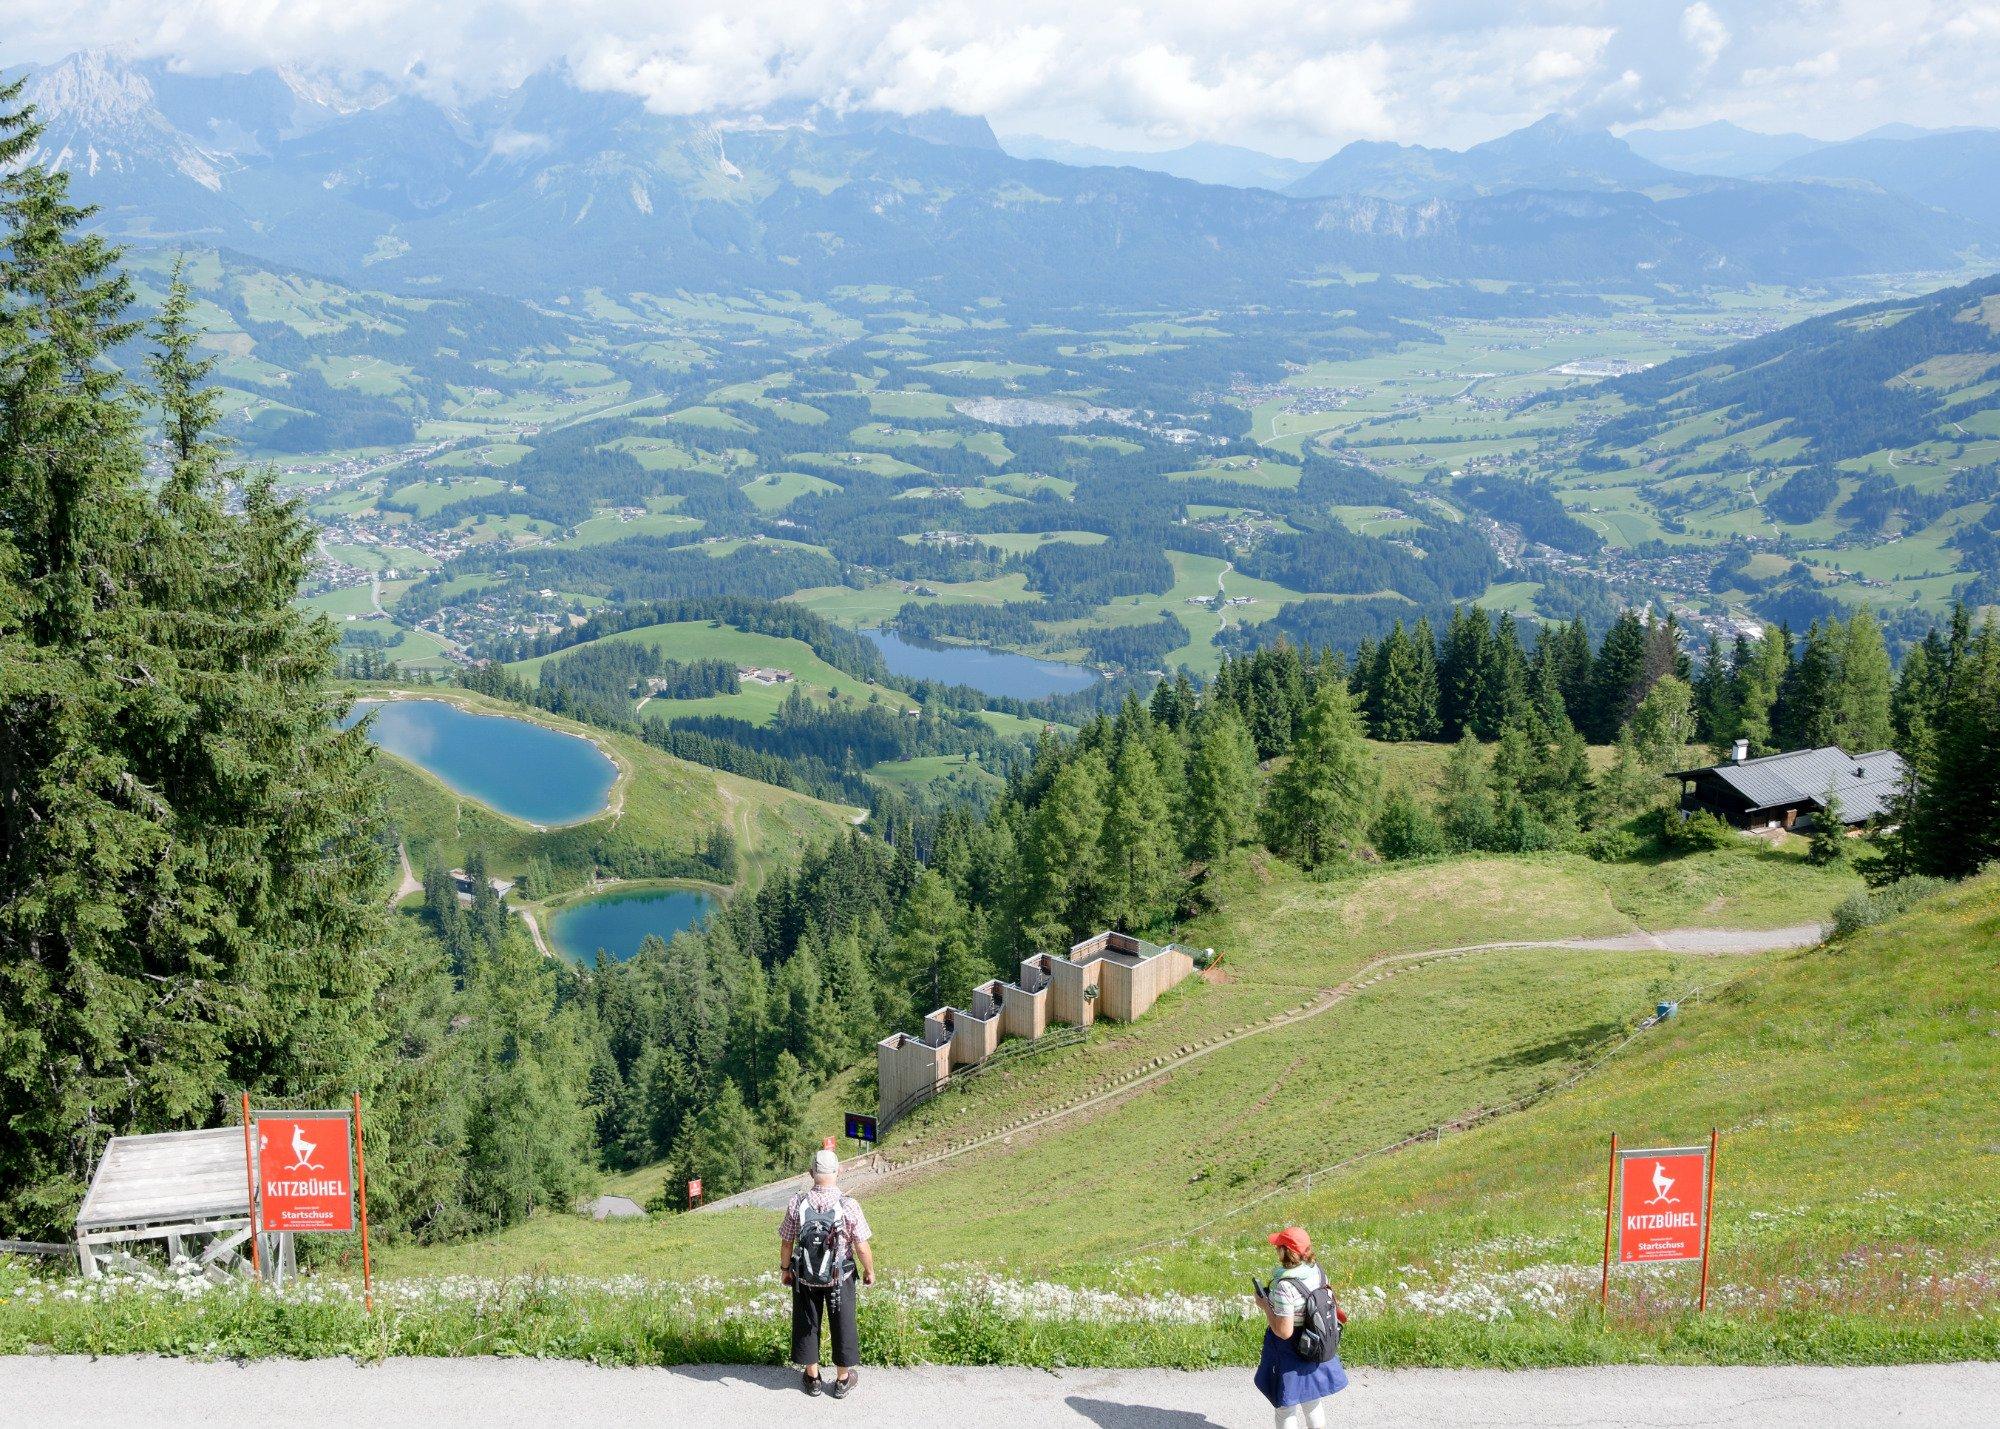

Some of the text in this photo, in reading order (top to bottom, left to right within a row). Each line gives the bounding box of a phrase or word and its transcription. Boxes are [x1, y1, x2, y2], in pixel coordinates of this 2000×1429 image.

[267, 1178, 347, 1197] KITZBÜHEL
[281, 1210, 334, 1219] Startschuss
[1627, 1211, 1698, 1230] KITZBÜHEL
[1638, 1241, 1685, 1250] Startschuss
